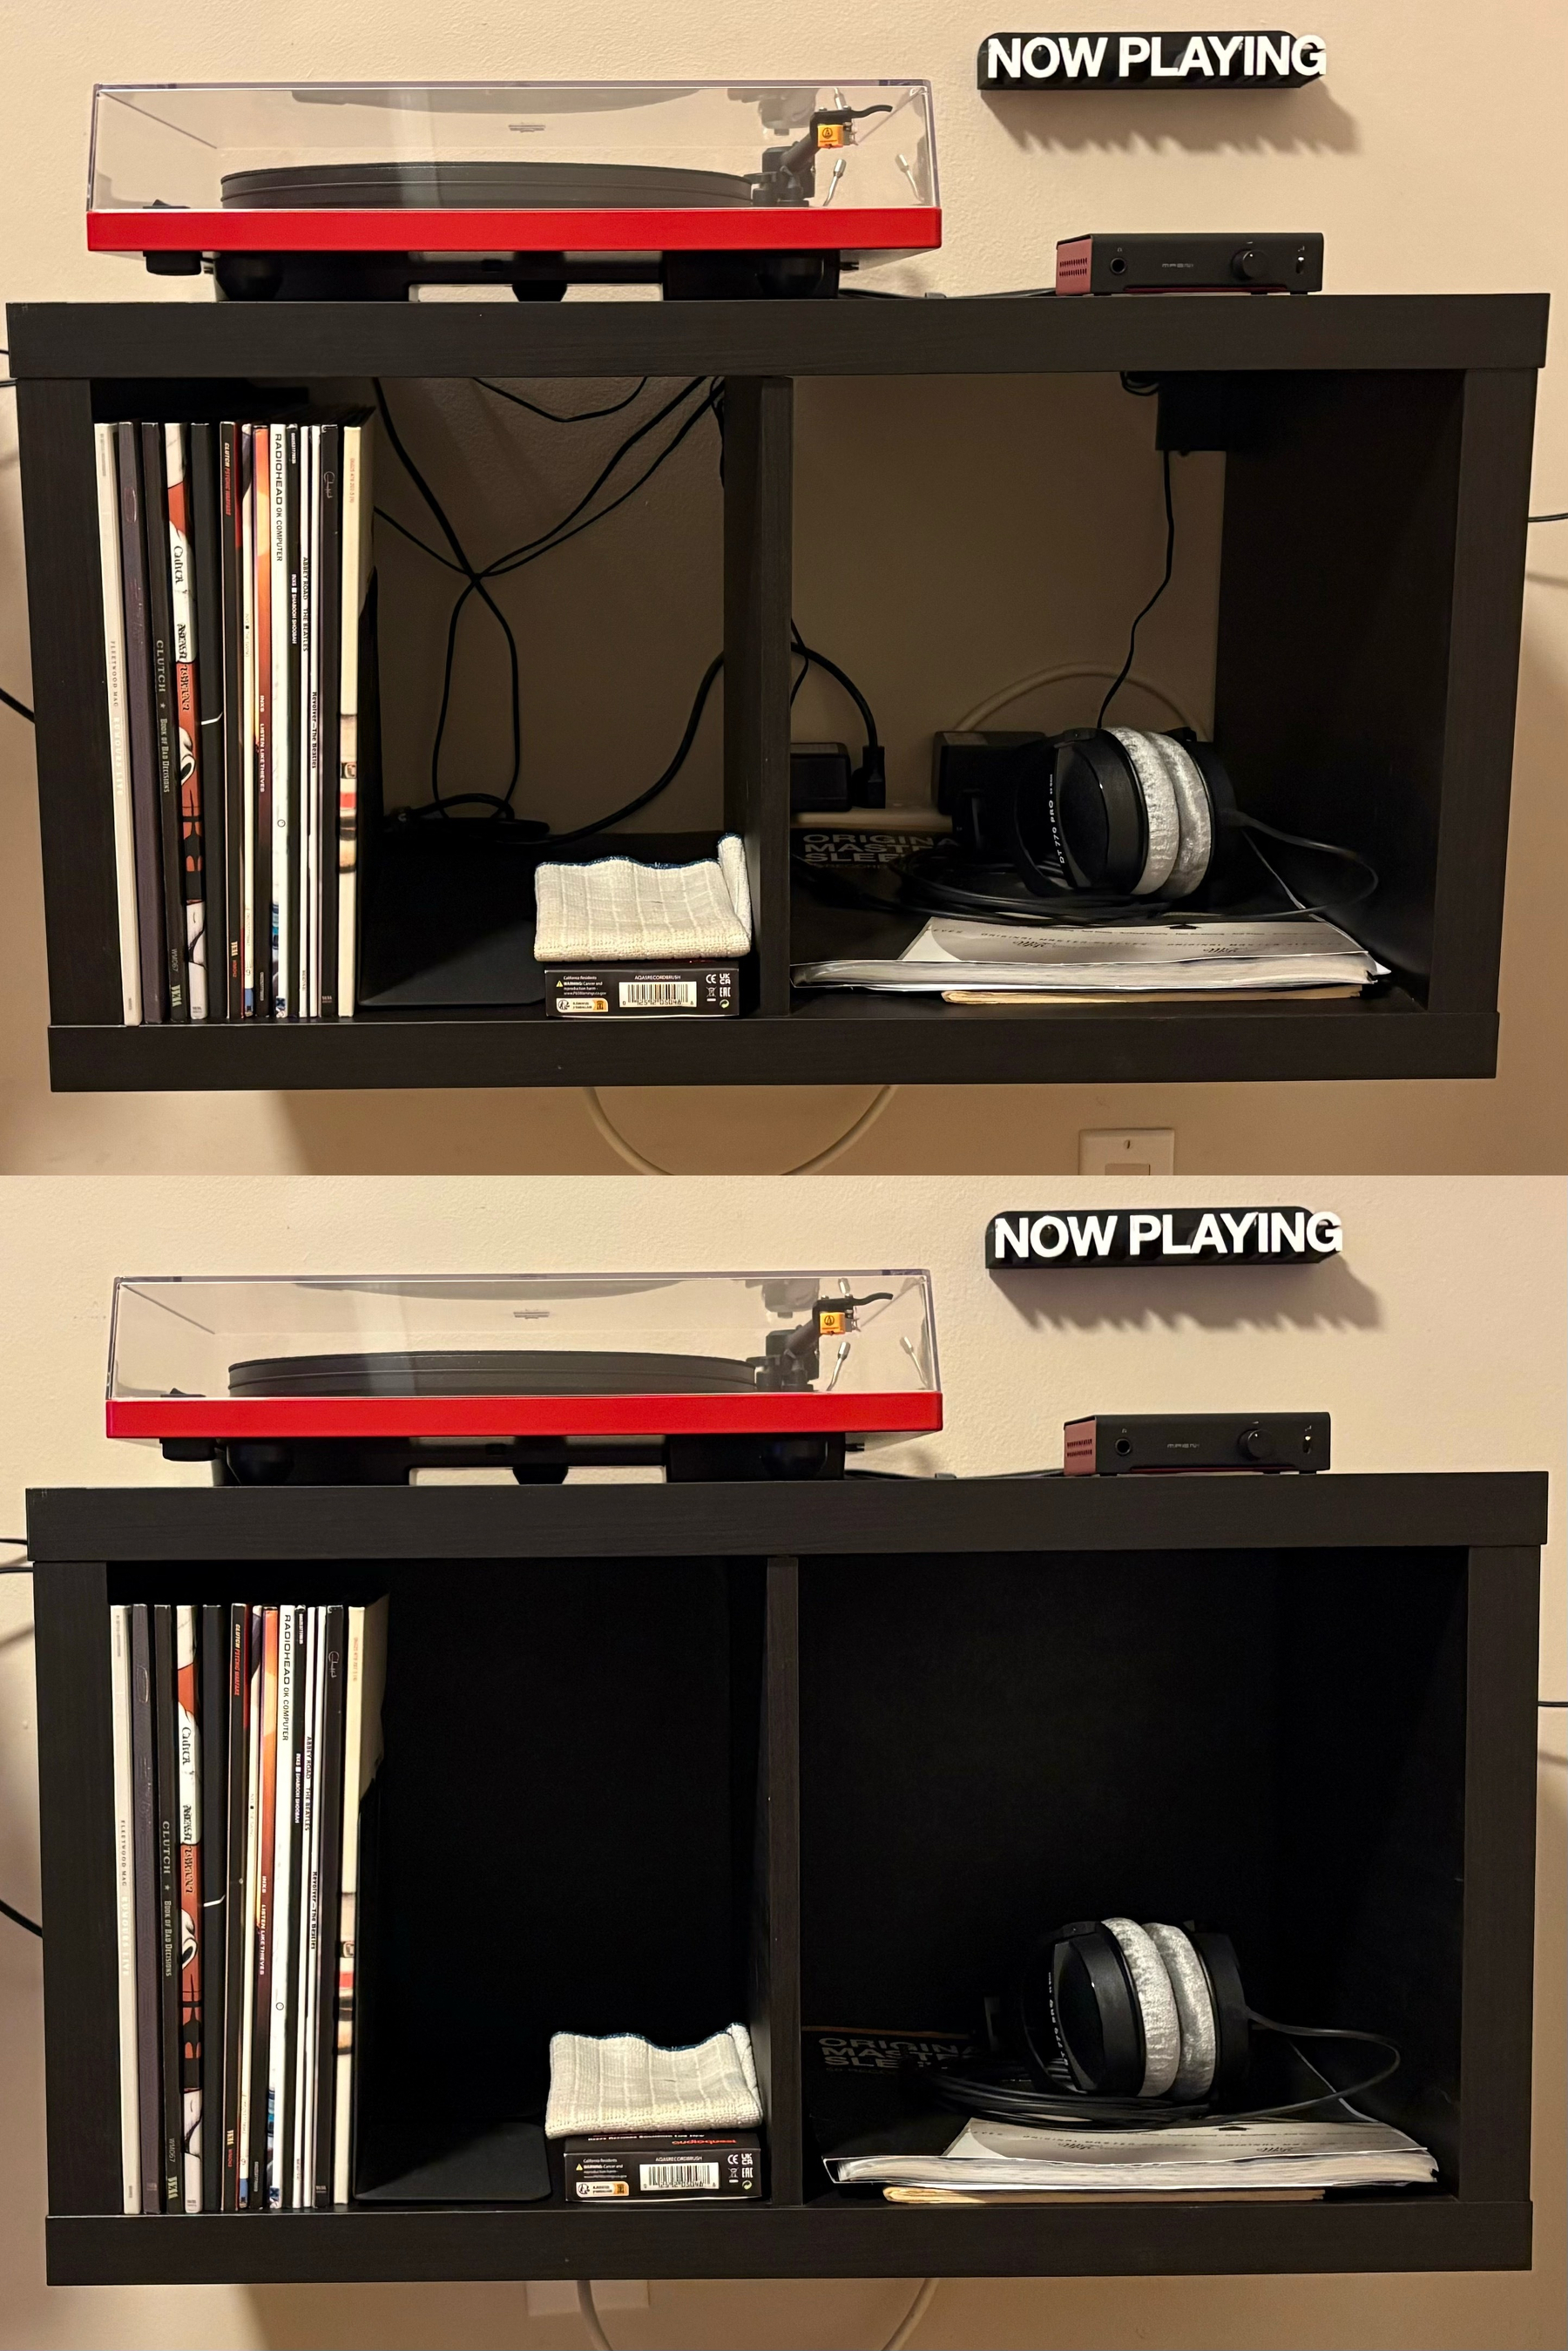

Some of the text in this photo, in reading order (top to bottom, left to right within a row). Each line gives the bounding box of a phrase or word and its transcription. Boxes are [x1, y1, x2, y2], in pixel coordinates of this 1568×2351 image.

[987, 34, 1327, 78] NOW PLAYING
[274, 433, 283, 505] RADIOHEAD
[275, 507, 283, 518] OK
[110, 640, 118, 689] FLEETWOOD
[156, 639, 166, 692] CLUTCH
[1051, 827, 1061, 847] 770
[1057, 849, 1065, 864] DT
[706, 974, 717, 984] CE
[994, 1211, 1343, 1259] NOW PLAYING
[281, 1614, 292, 1741] RADIOHEAD OK COMPUTER
[162, 1821, 172, 1874] CLUTCH
[727, 2154, 739, 2165] CE
